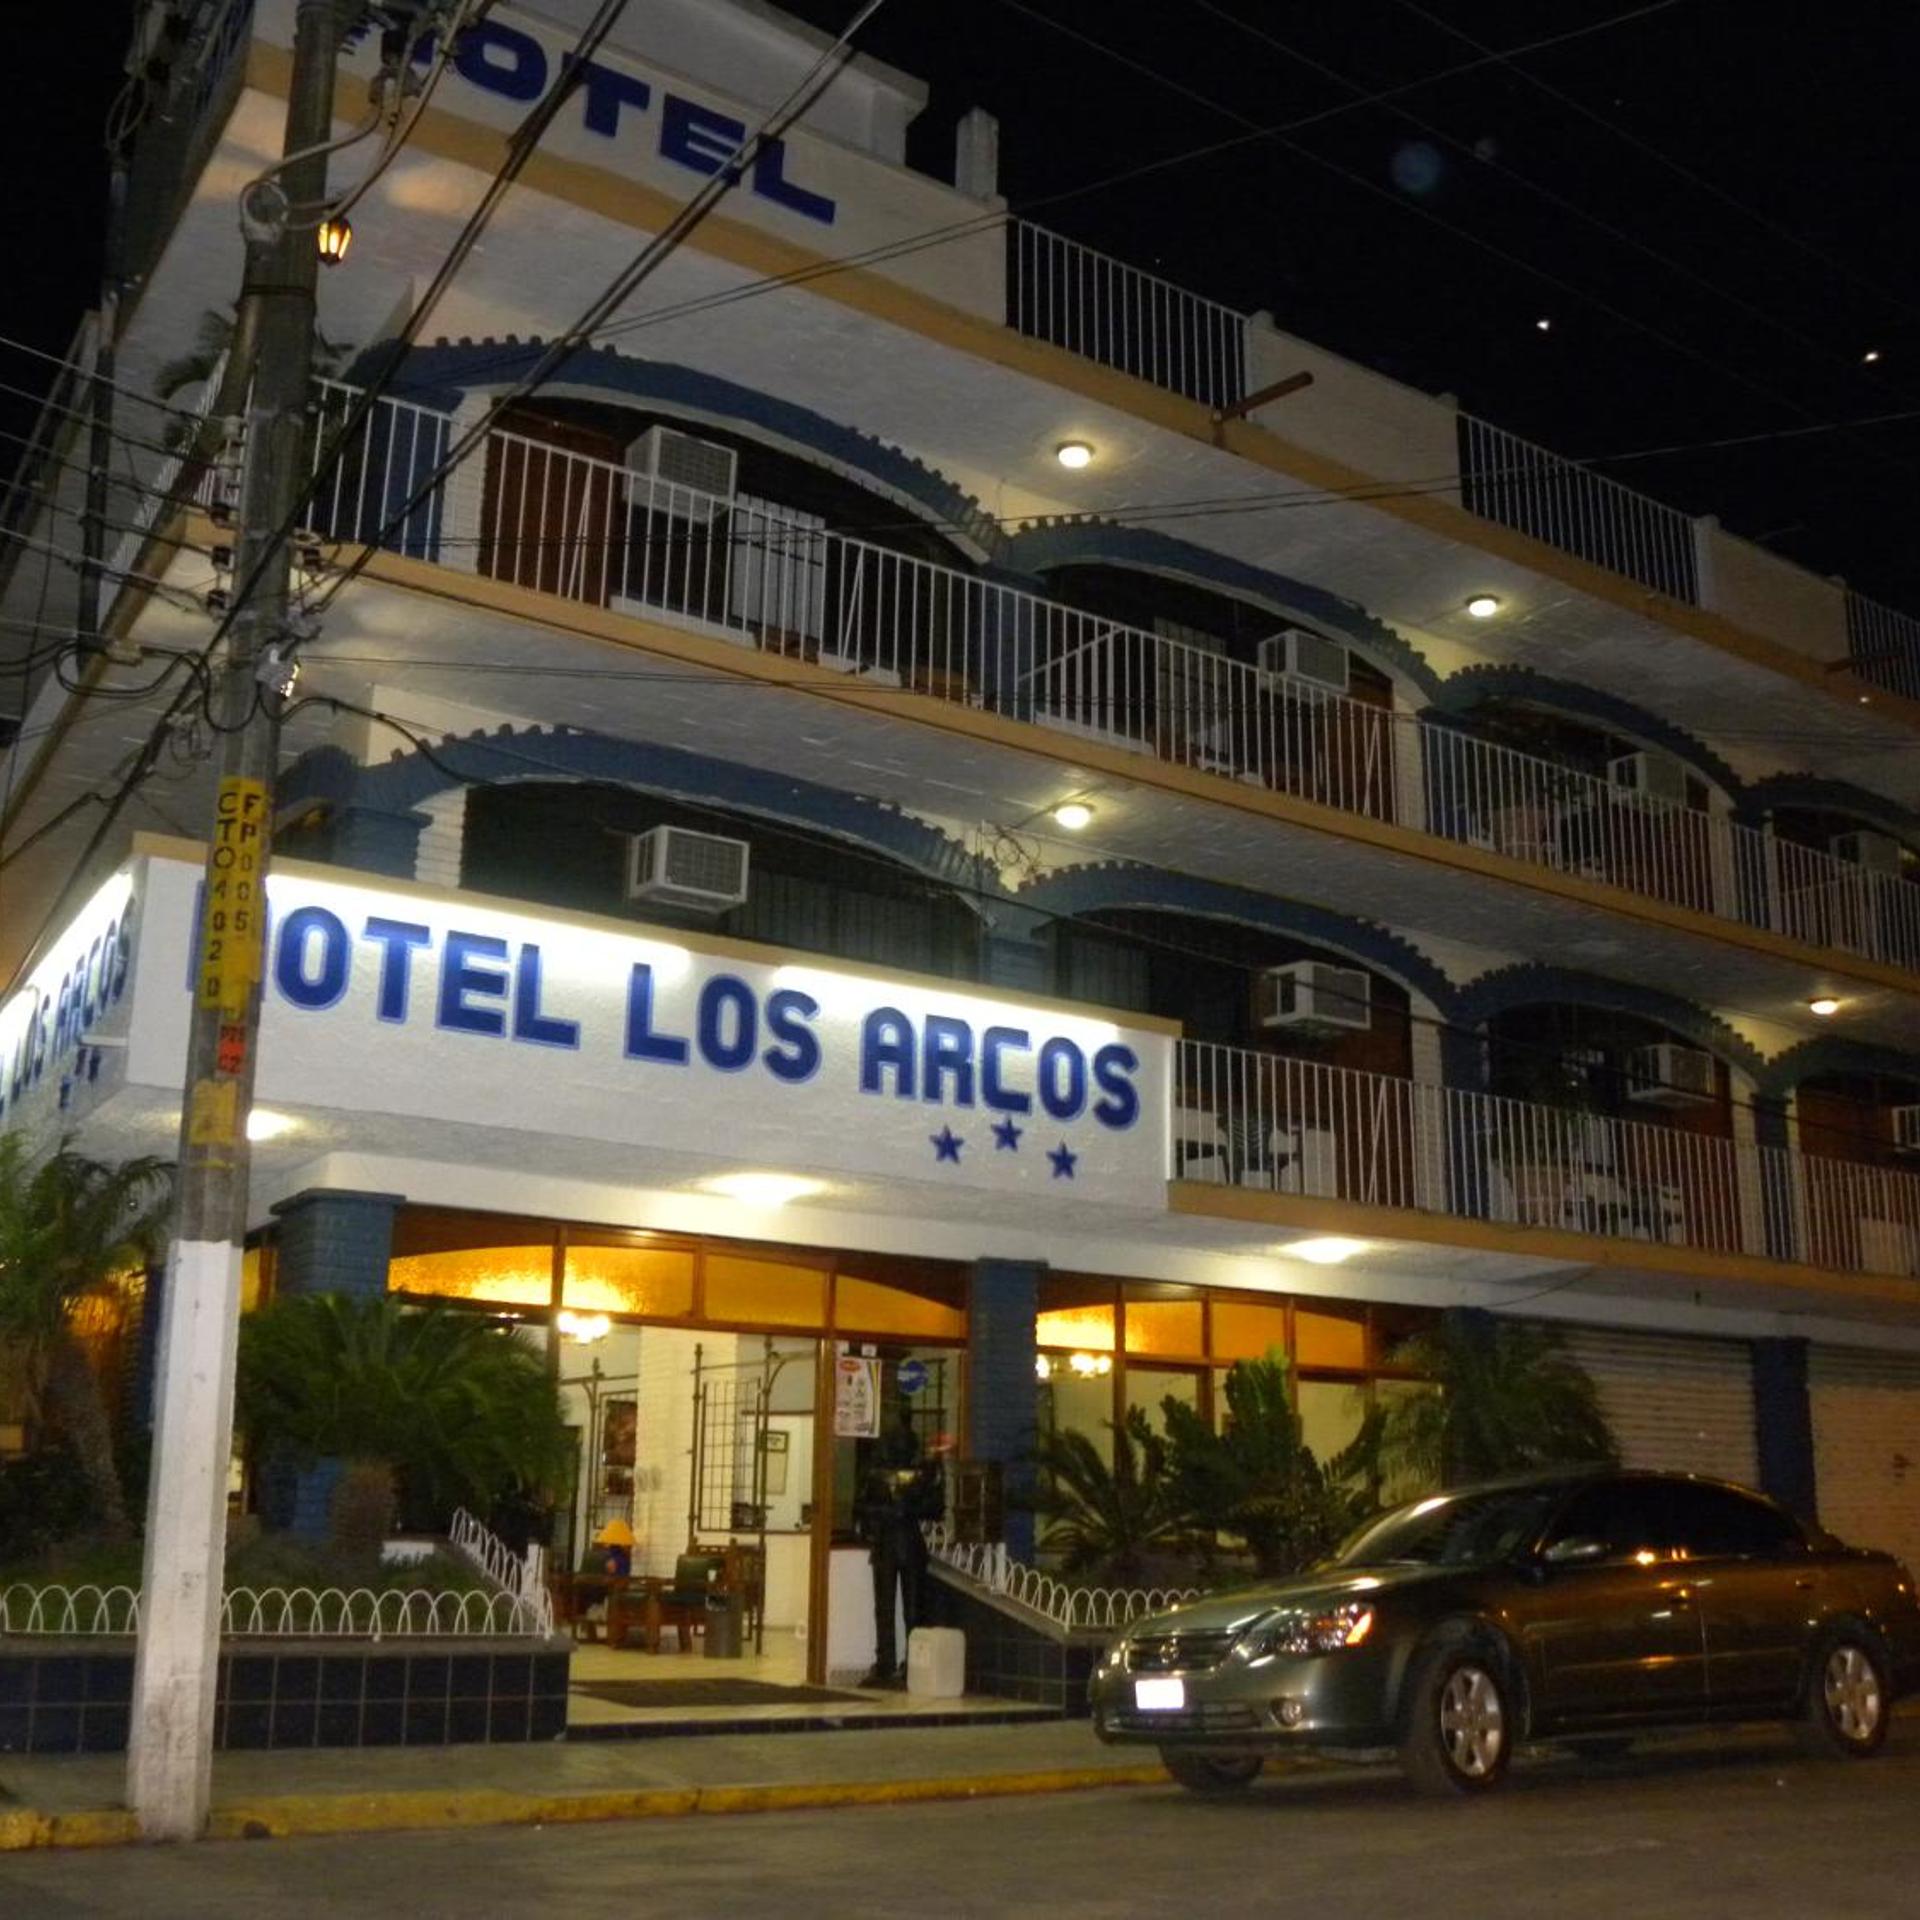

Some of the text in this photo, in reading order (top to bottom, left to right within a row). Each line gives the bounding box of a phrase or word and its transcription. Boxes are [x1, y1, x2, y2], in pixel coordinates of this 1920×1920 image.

[340, 15, 835, 225] OTEL
[624, 962, 822, 1084] LOS
[859, 1005, 1141, 1132] ARCOS
